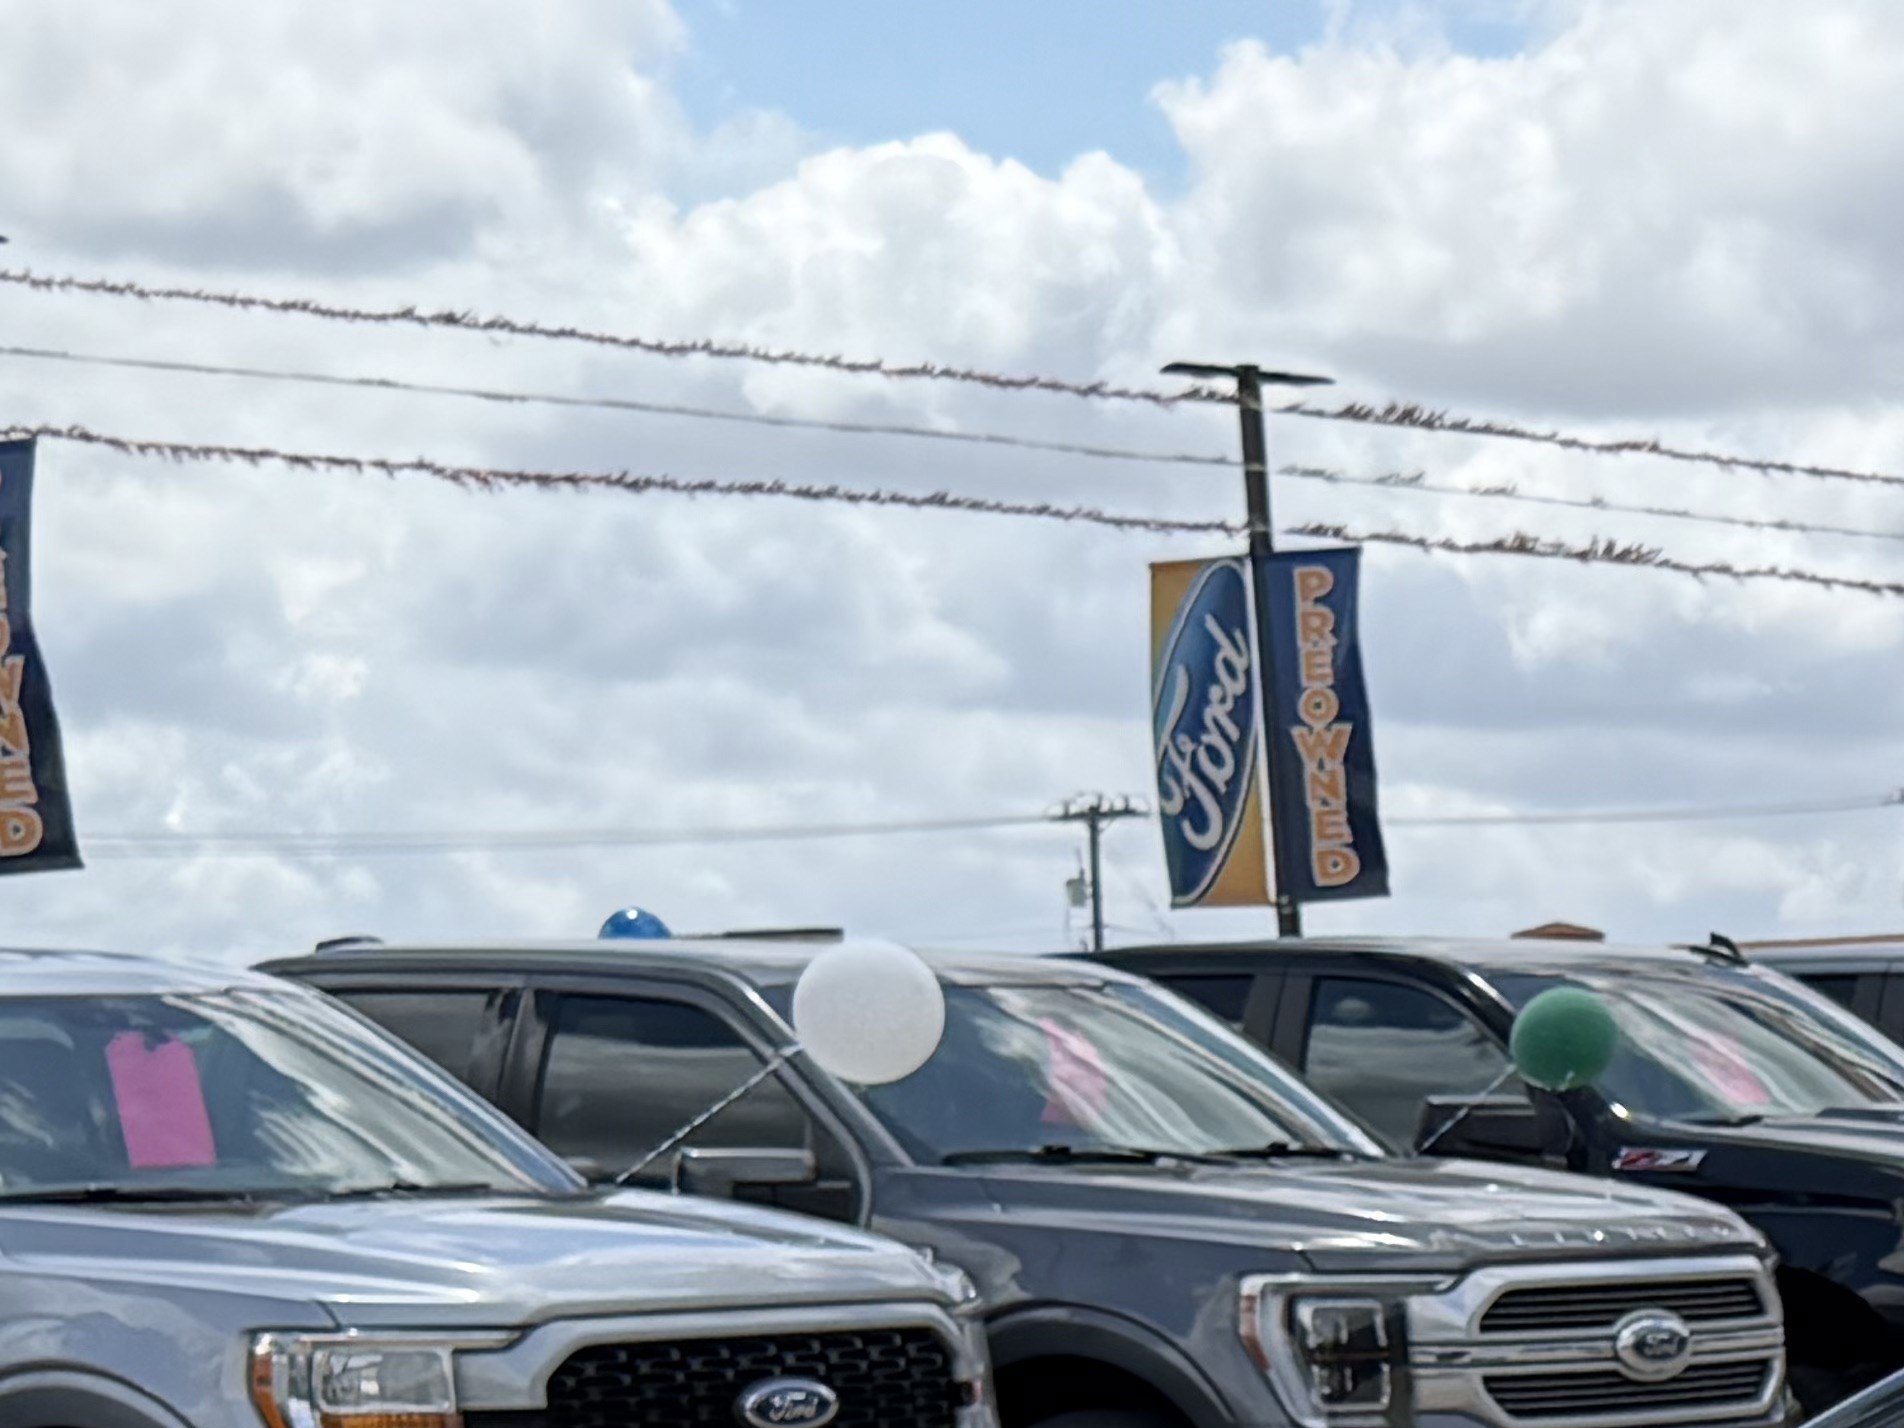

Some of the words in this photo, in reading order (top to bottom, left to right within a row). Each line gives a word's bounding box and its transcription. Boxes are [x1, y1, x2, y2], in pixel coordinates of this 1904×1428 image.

[1157, 612, 1250, 851] Ford
[1290, 565, 1361, 887] PREOWNED
[769, 1391, 819, 1421] Ford
